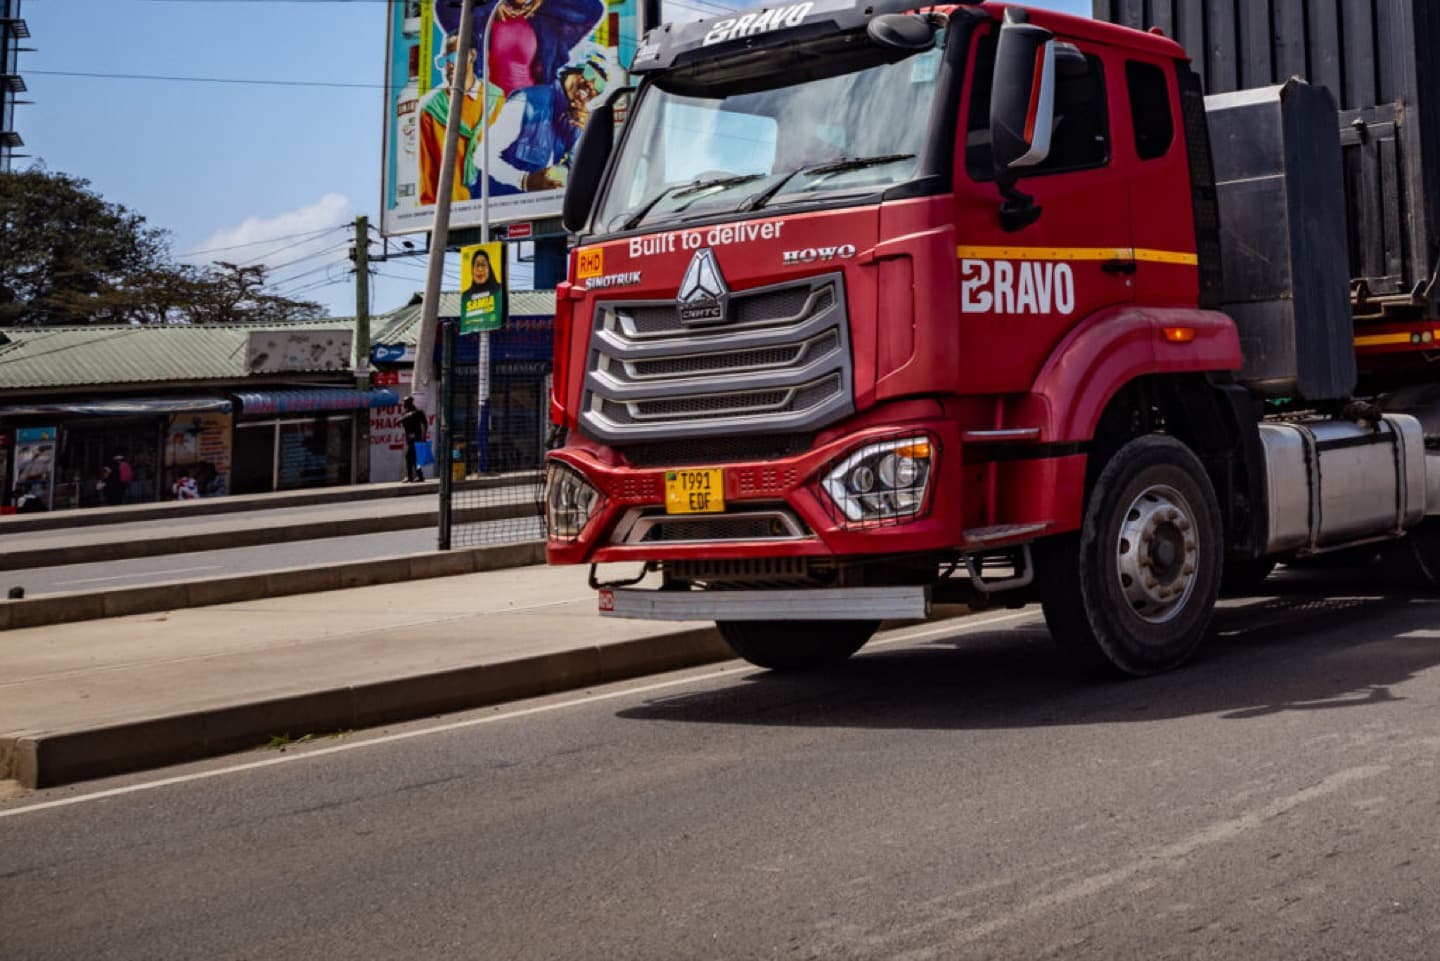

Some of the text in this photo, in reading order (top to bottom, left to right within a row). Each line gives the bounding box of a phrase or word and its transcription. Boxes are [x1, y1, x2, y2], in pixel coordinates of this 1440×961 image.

[703, 1, 814, 47] BRAVO
[629, 220, 784, 258] Built to deliver
[783, 244, 856, 265] HOWO
[580, 255, 600, 275] RHD
[585, 271, 641, 289] SINOTRUK
[961, 259, 1075, 315] BRAVO
[681, 472, 711, 490] T991
[689, 492, 711, 510] EDF
